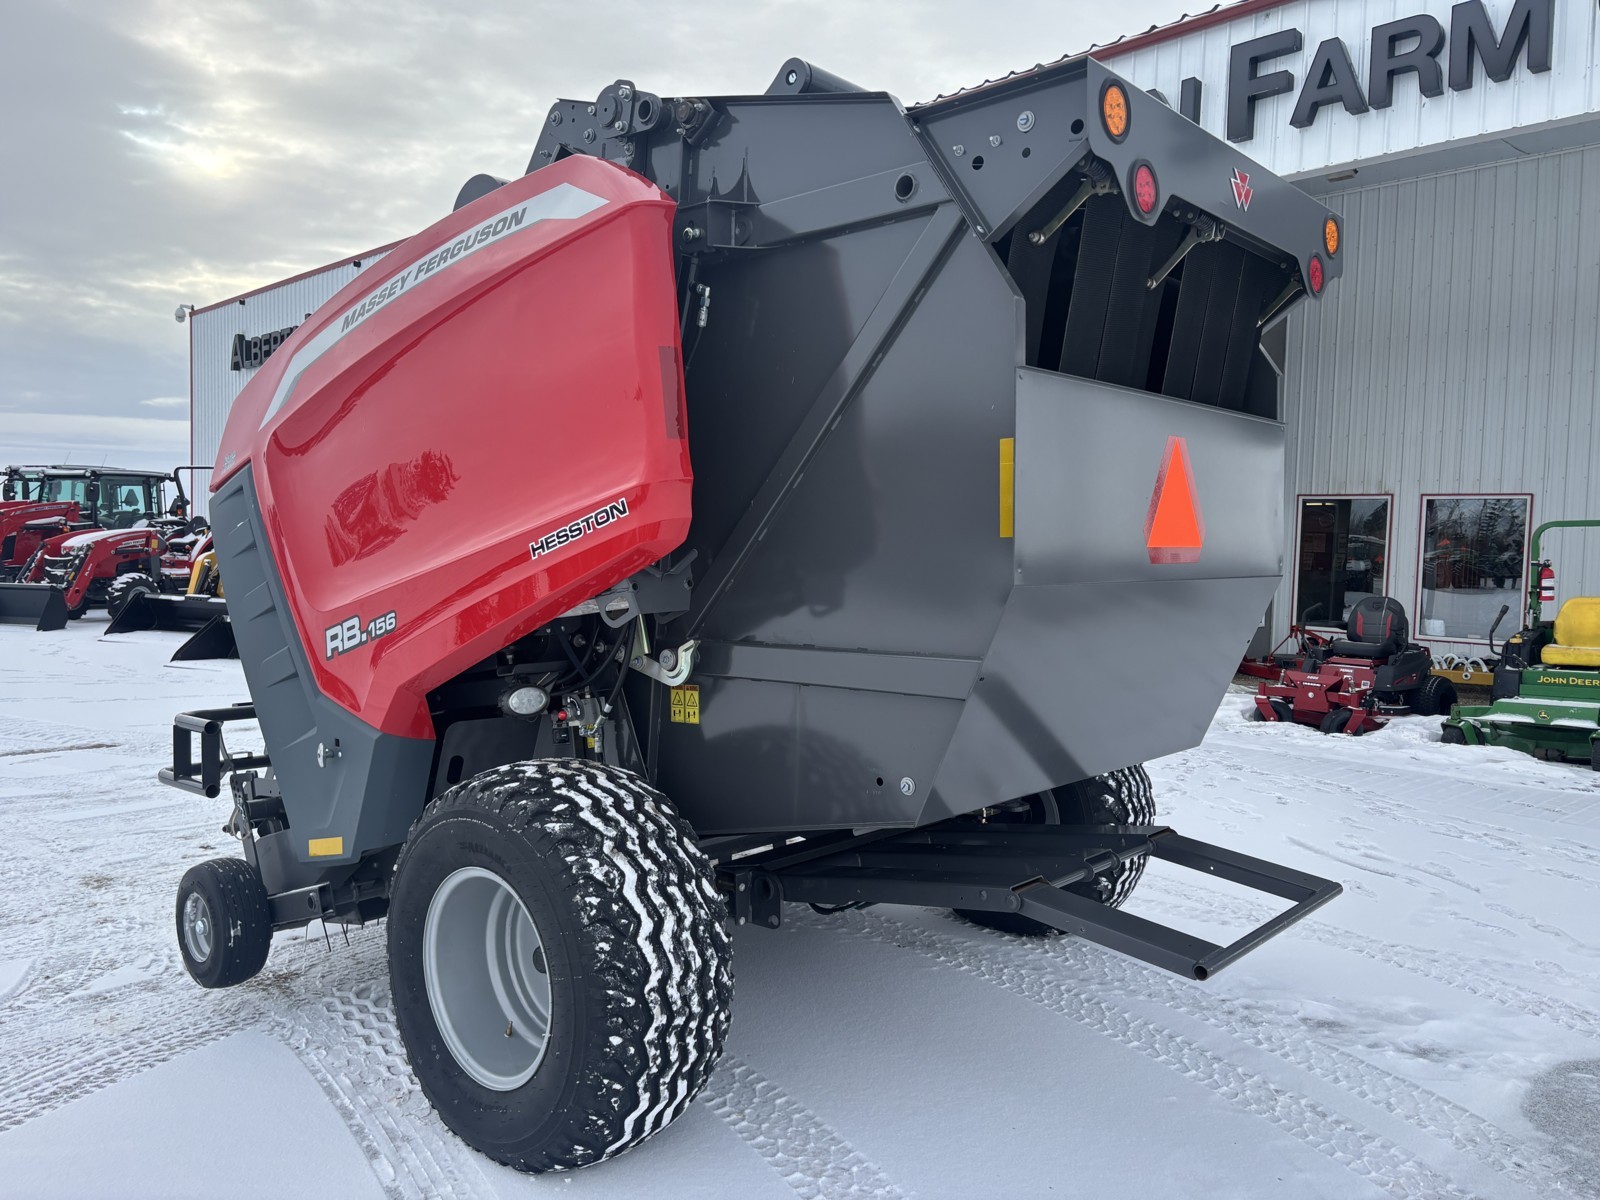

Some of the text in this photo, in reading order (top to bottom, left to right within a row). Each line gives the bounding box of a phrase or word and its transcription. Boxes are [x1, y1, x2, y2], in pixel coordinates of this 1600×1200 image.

[1227, 0, 1556, 142] FARM
[341, 207, 527, 332] MASSEY FERGUSON
[231, 325, 300, 371] ALBERT
[529, 498, 629, 560] HESSTON
[1537, 675, 1567, 684] JOHN
